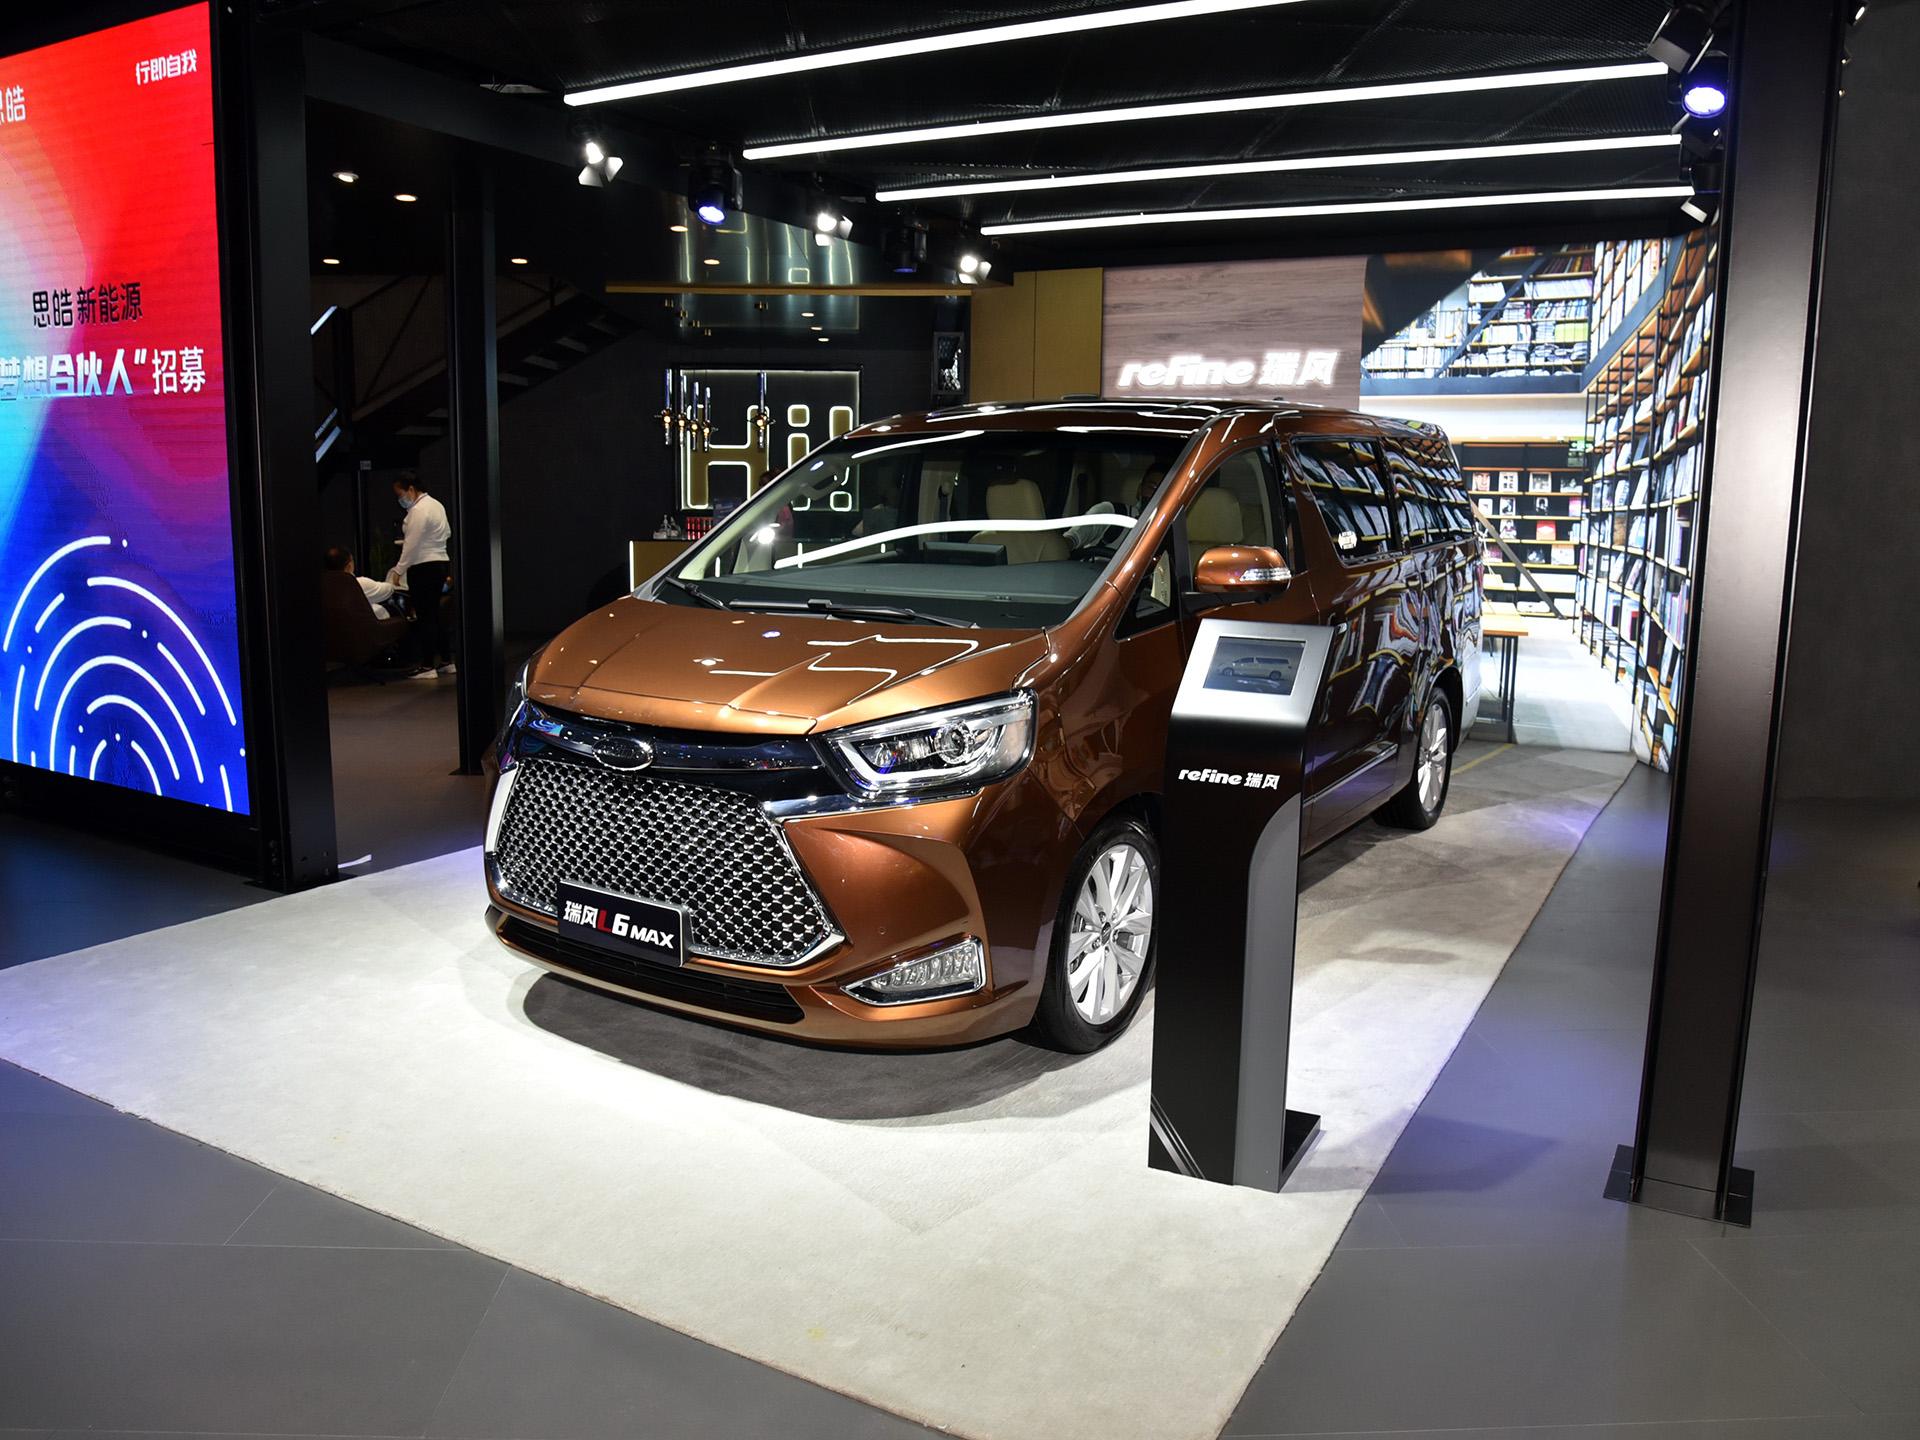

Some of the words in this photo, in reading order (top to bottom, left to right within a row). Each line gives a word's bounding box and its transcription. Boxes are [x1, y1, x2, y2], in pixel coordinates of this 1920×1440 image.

[135, 49, 198, 86] 行即自我
[32, 281, 144, 329] 思皓新能源
[1258, 350, 1340, 386] 瑞风
[1244, 772, 1280, 790] 瑞风
